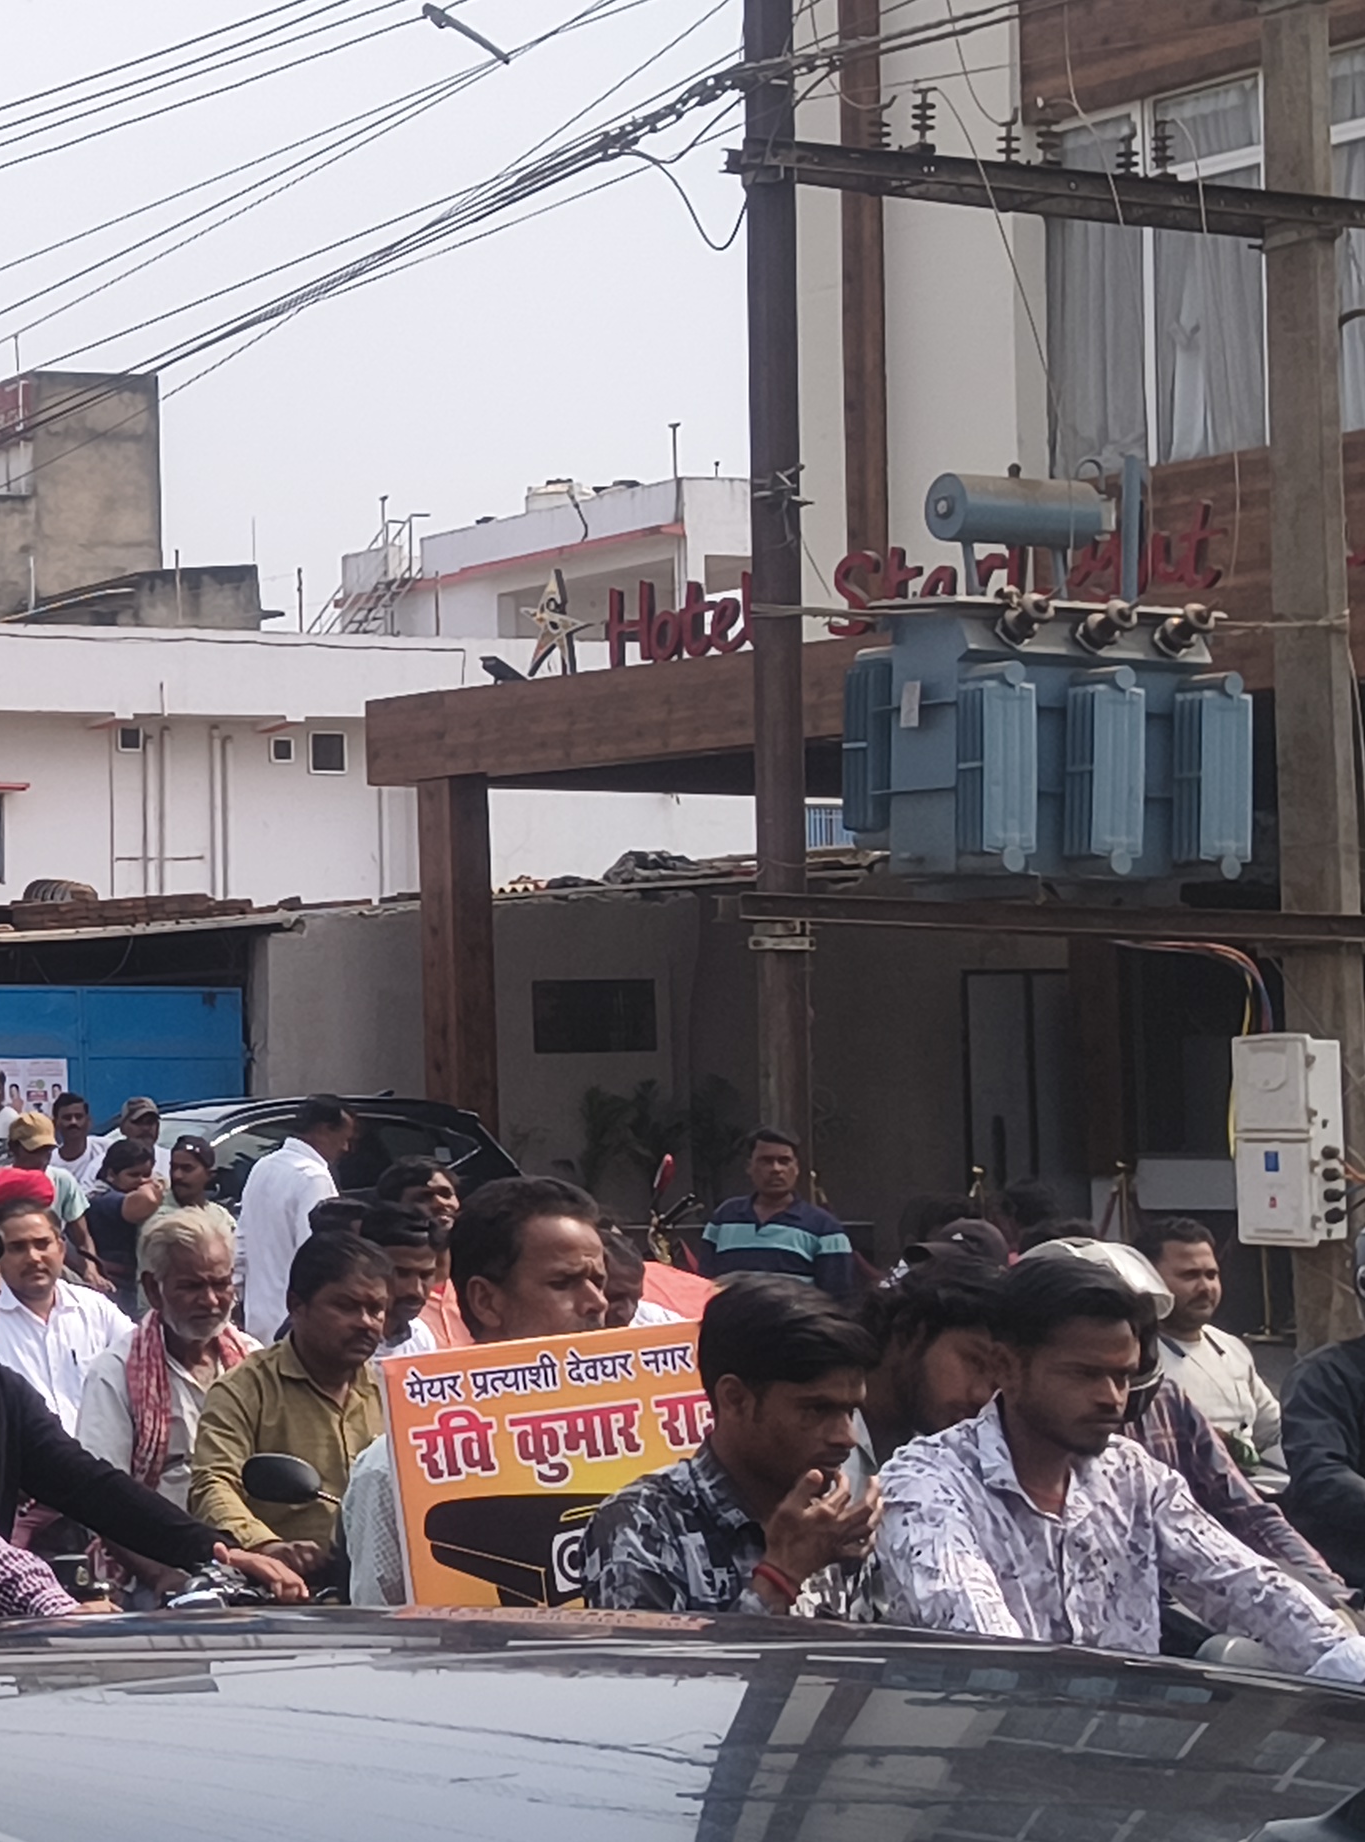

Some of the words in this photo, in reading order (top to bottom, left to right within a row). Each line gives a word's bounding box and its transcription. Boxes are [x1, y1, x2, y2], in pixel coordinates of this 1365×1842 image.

[607, 571, 754, 668] Hotel
[406, 1371, 462, 1404] मेयर
[470, 1353, 559, 1400] प्रत्याशी
[566, 1350, 634, 1384] देवघर
[640, 1345, 693, 1374] नगर
[412, 1409, 496, 1480] रवि
[508, 1400, 642, 1484] कुमार
[653, 1393, 716, 1448] रा
